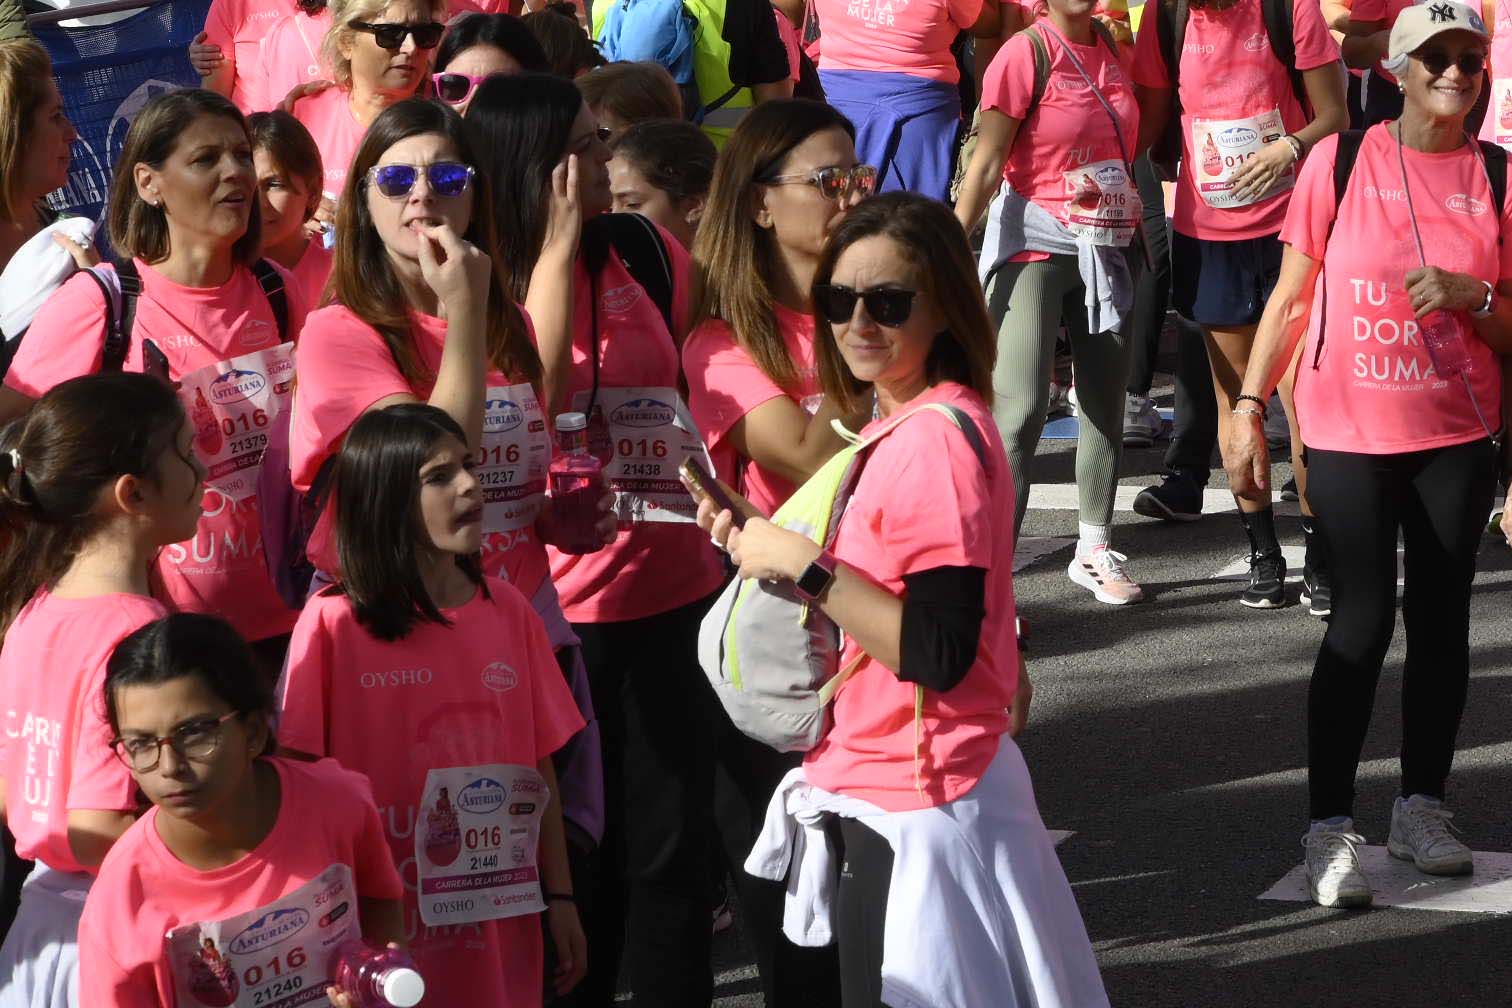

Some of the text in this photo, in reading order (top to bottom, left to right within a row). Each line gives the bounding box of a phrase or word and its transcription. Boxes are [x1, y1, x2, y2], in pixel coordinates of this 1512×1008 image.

[847, 4, 894, 26] MUJER
[1350, 279, 1388, 305] TU
[1353, 316, 1419, 346] DOR
[222, 408, 268, 436] 016
[230, 434, 268, 454] 21379
[618, 439, 667, 457] 016
[624, 463, 661, 476] 21438
[360, 668, 433, 689] OYSHO
[465, 826, 501, 849] 016
[470, 855, 498, 870] 21440
[435, 878, 473, 889] CARRERA
[433, 899, 474, 914] OYSHO
[238, 916, 306, 951] ASTURIANA
[244, 946, 306, 987] 016
[254, 975, 303, 1005] 21240
